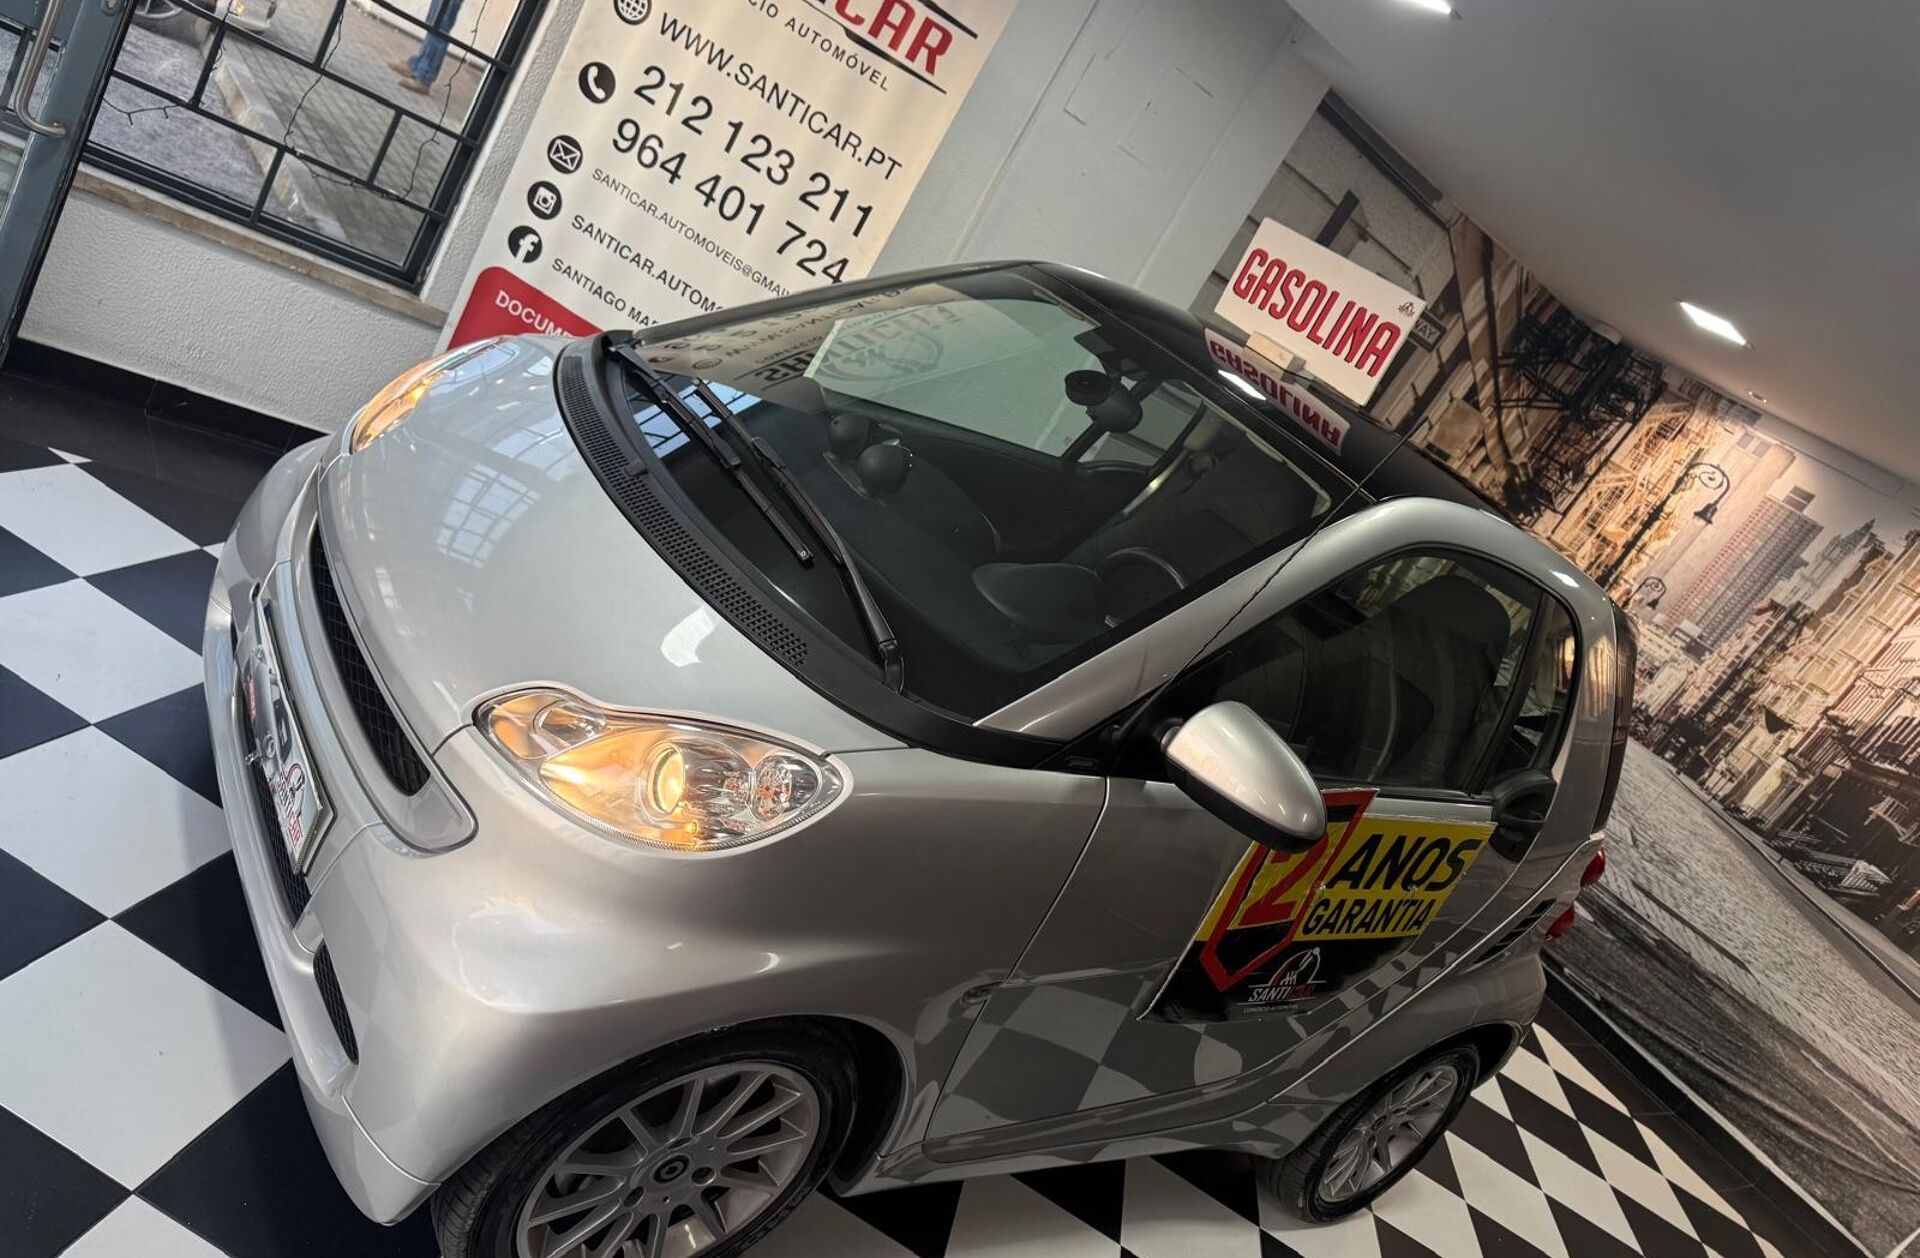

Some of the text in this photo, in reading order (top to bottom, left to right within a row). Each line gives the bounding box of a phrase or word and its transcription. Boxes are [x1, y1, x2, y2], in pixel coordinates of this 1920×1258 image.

[659, 12, 903, 181] WWW.SANTICAR.PT
[784, 17, 889, 92] AUTOMÓVEL
[634, 65, 874, 239] 212 123 211
[612, 118, 850, 284] 964 401 724
[551, 257, 626, 312] SANTIAGO
[571, 214, 723, 312] SANTICAR.AUTOM
[495, 290, 573, 339] DOCUM
[1232, 248, 1402, 378] GASOLINA
[1326, 834, 1484, 892] ANOS
[1302, 898, 1436, 936] GARANTIA
